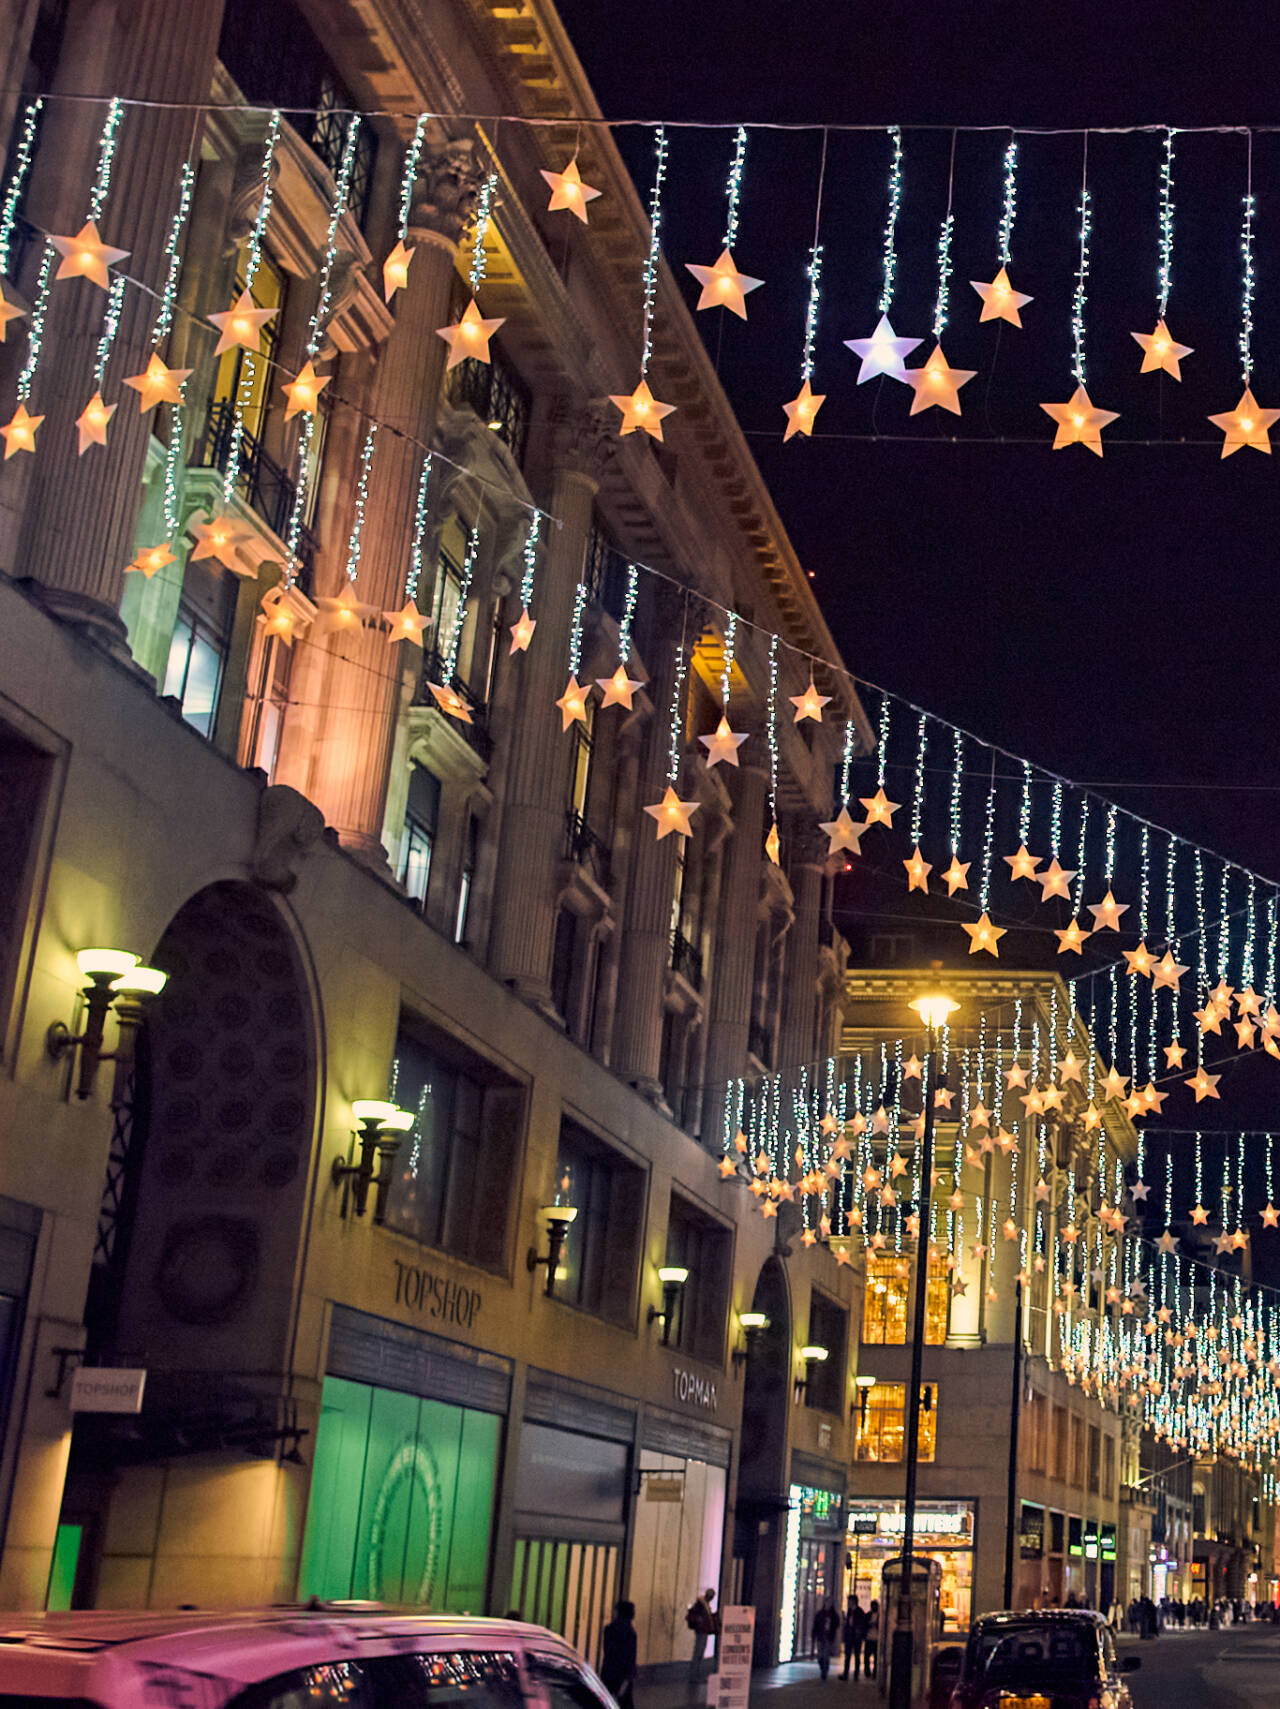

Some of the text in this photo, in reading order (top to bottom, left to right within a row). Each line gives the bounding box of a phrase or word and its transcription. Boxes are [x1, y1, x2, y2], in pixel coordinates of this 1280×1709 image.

[394, 1259, 481, 1328] TOPSHOP
[76, 1382, 139, 1397] TOPSHOP
[673, 1368, 718, 1410] TOPMAN
